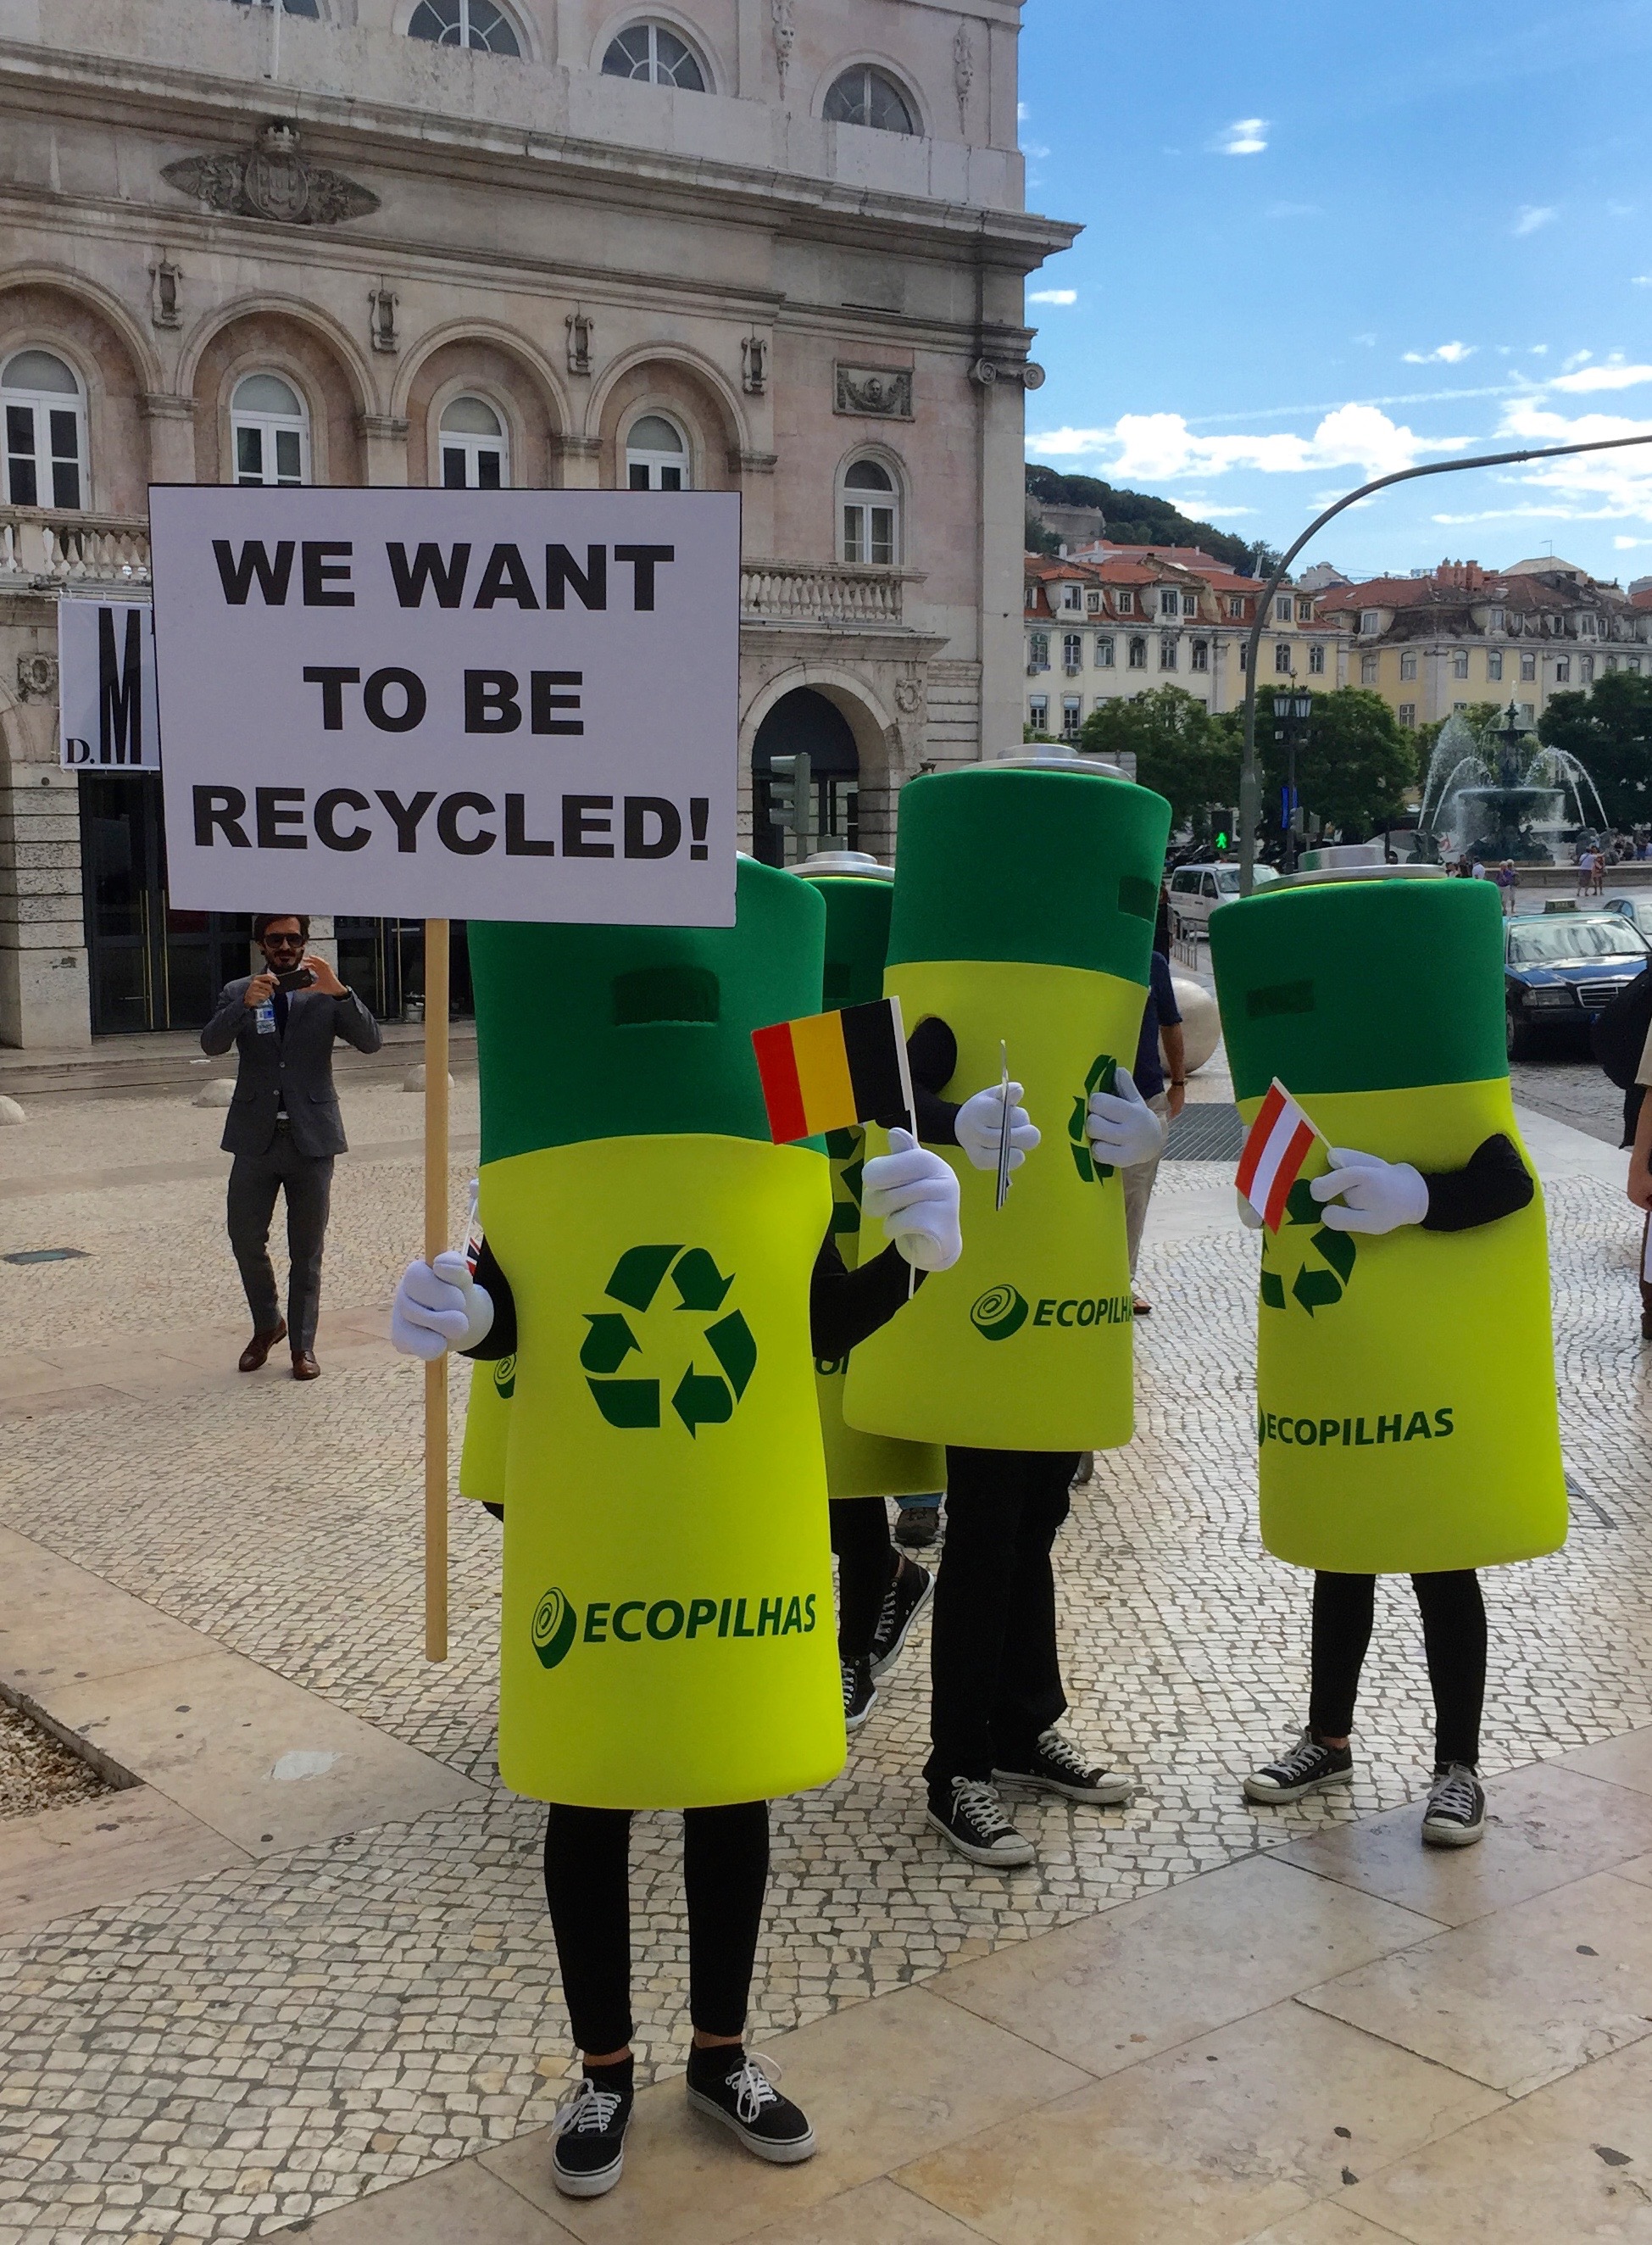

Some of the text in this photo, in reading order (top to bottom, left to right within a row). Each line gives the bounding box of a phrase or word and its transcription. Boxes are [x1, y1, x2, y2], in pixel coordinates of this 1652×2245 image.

[212, 540, 675, 612] WE WANT
[303, 666, 585, 736] TO BE
[192, 784, 710, 862] RECYCLED!
[1266, 1407, 1455, 1446] ECOPILHAS
[583, 1593, 816, 1643] ECOPILHAS
